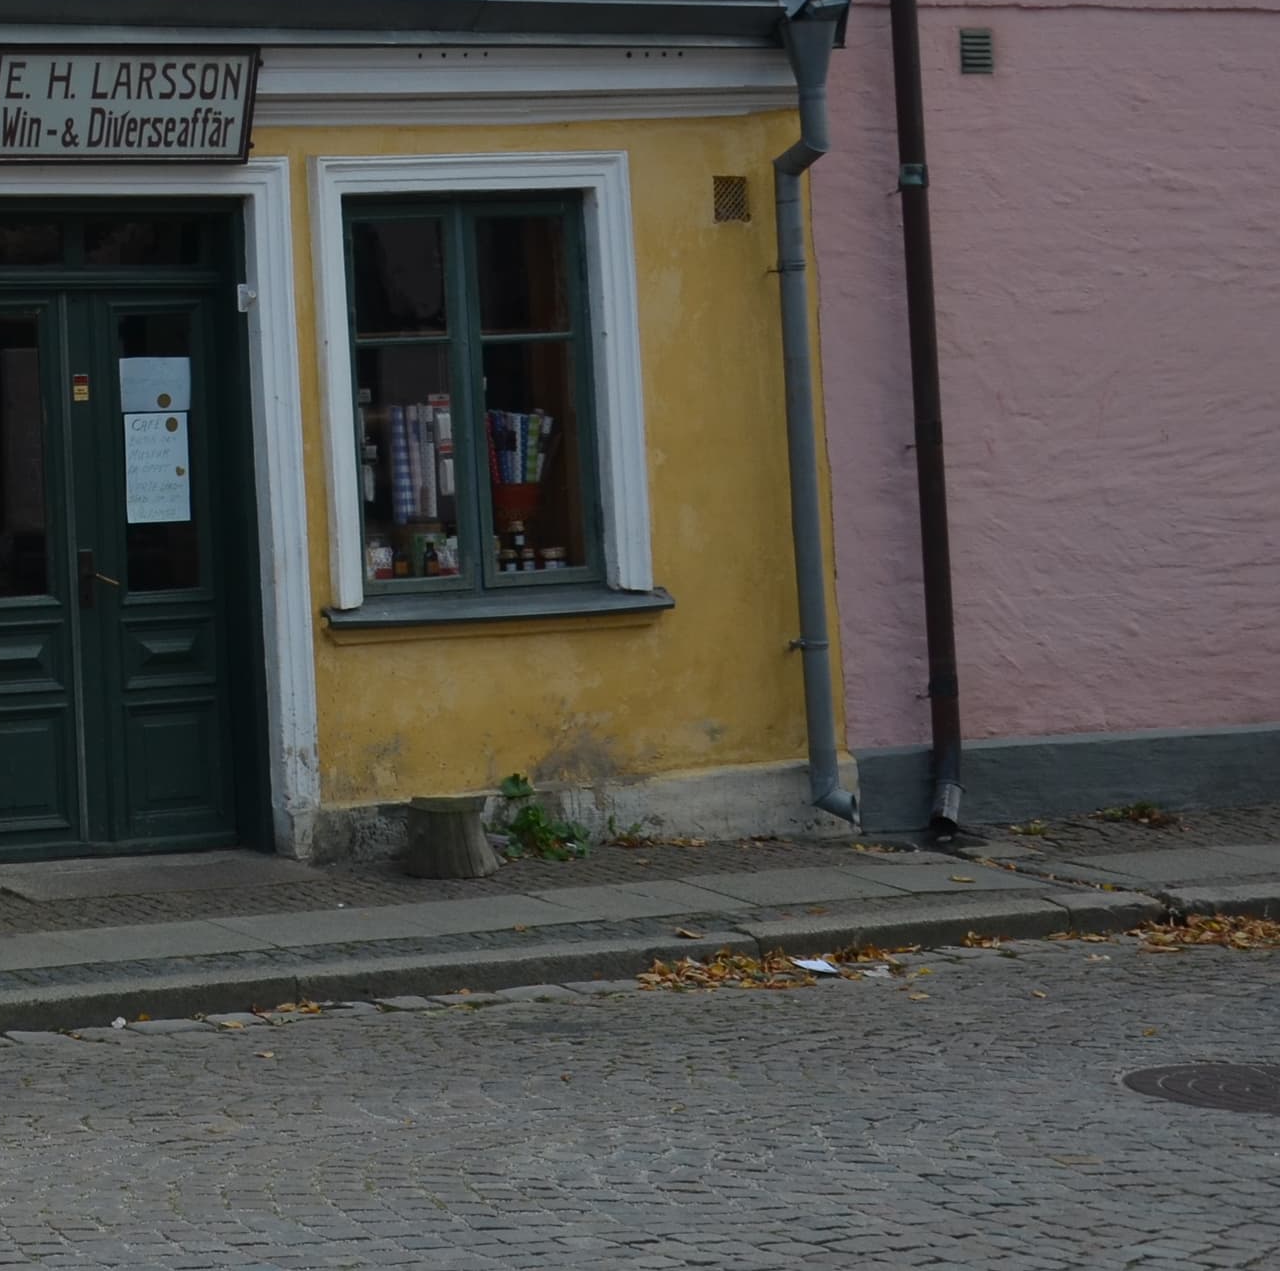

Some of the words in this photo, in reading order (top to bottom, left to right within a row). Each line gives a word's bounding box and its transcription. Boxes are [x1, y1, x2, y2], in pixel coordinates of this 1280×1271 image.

[4, 61, 31, 100] E.
[46, 61, 76, 100] H.
[90, 61, 242, 101] LARSSON
[87, 106, 235, 149] Diverseaffär
